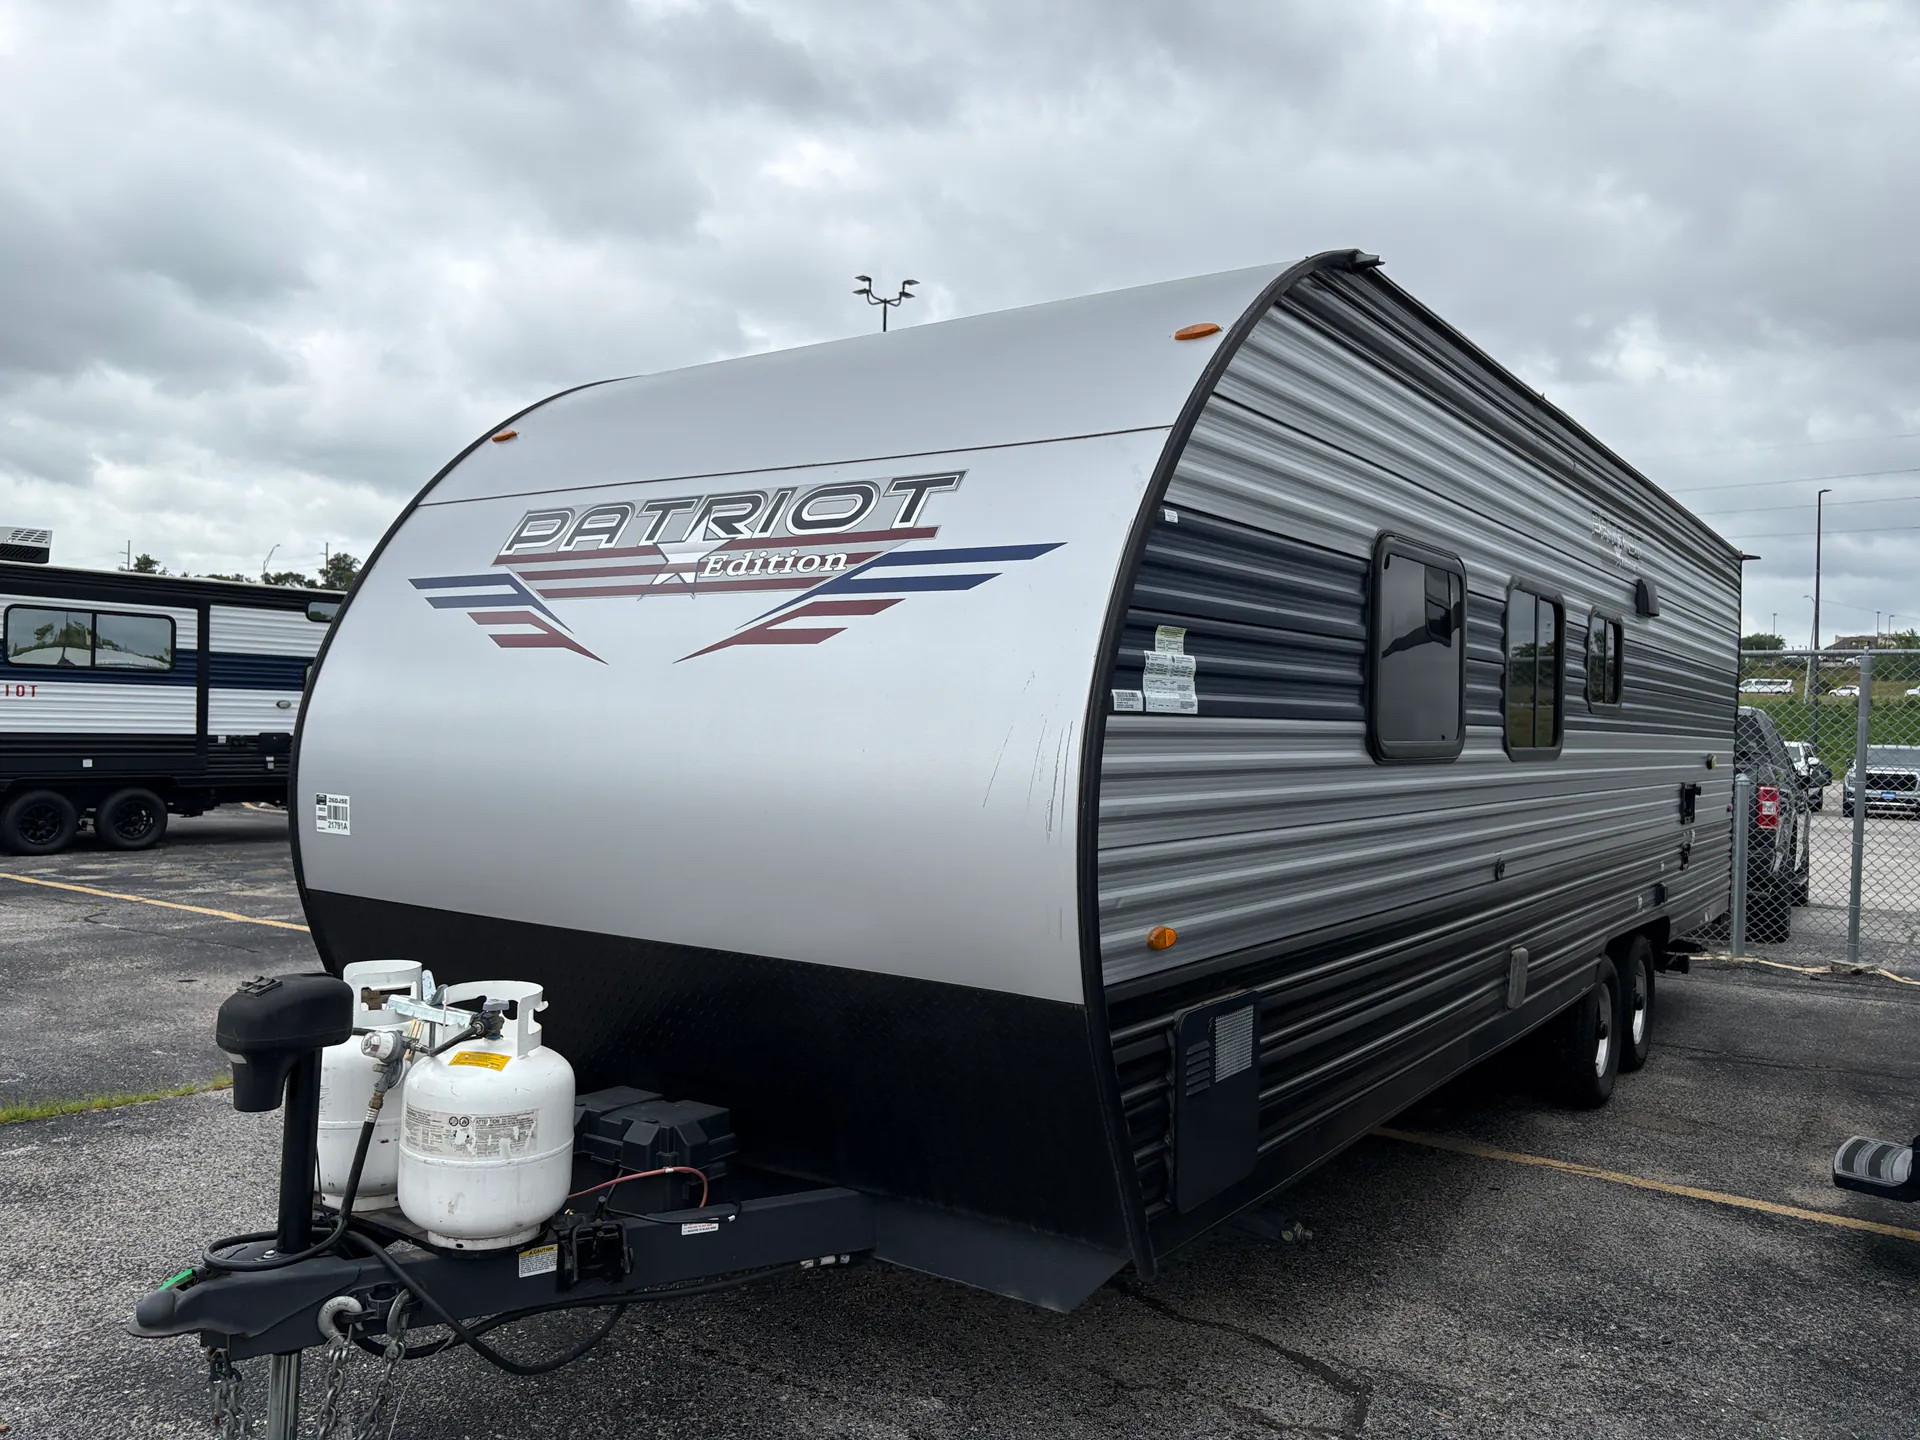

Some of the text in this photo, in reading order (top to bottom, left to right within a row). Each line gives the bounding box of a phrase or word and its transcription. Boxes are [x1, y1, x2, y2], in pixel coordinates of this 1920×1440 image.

[500, 469, 969, 556] PATRIOT
[701, 550, 848, 578] Edition
[327, 820, 348, 830] 21791A
[533, 1246, 554, 1255] CAUTION
